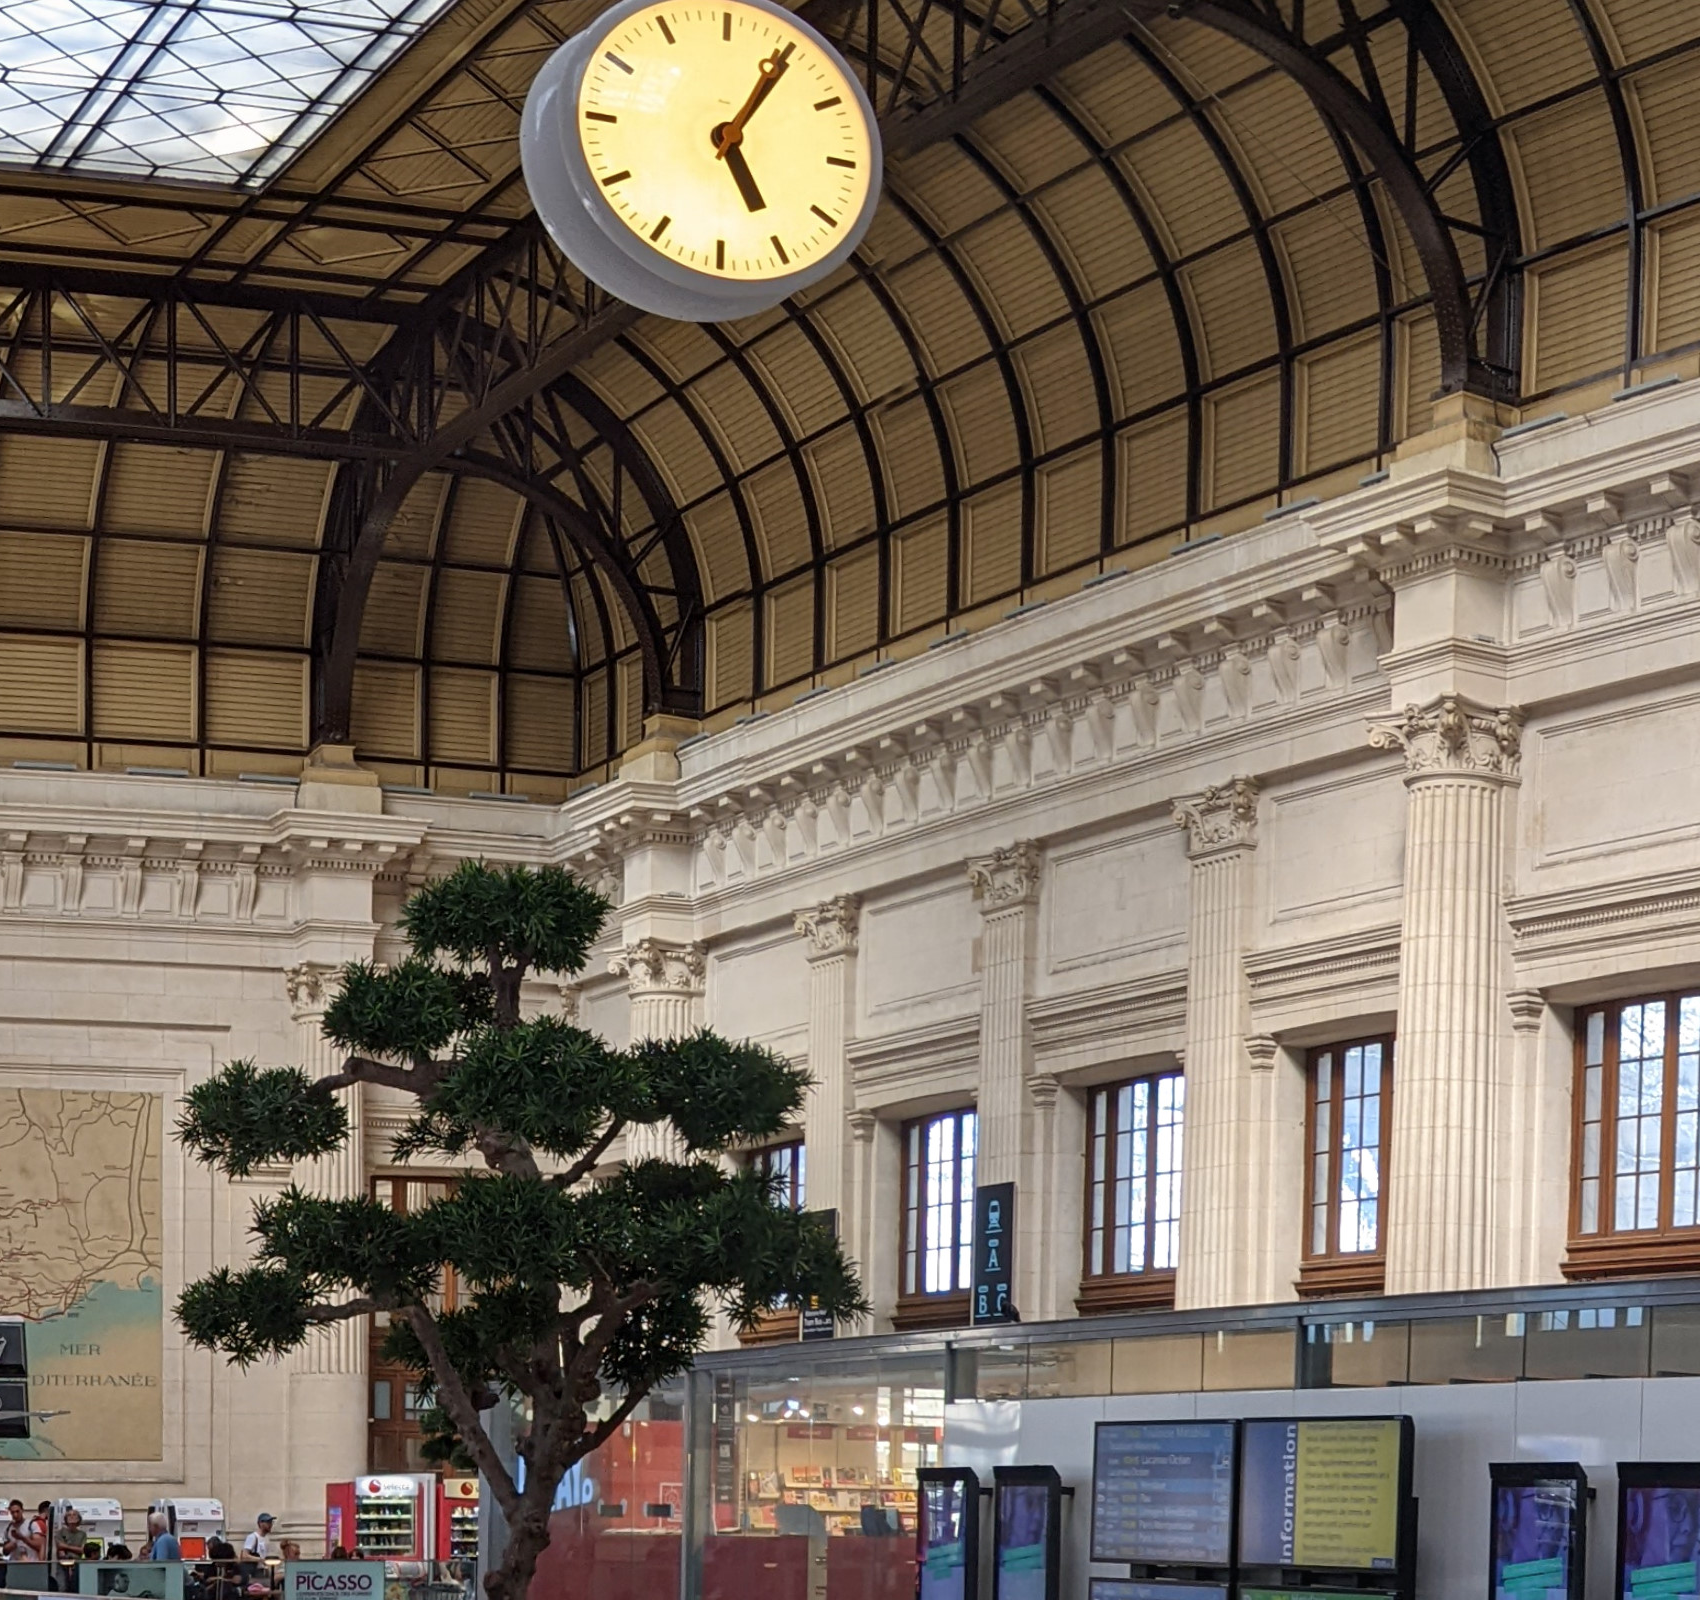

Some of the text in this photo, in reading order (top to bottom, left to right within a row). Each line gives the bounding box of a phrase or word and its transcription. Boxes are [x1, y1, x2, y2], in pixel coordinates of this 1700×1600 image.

[989, 1249, 999, 1268] A
[979, 1295, 988, 1314] B
[60, 1343, 101, 1356] MER
[31, 1373, 157, 1387] DITERRANÉE
[1279, 1424, 1297, 1564] information
[296, 1574, 373, 1590] PICASSO
